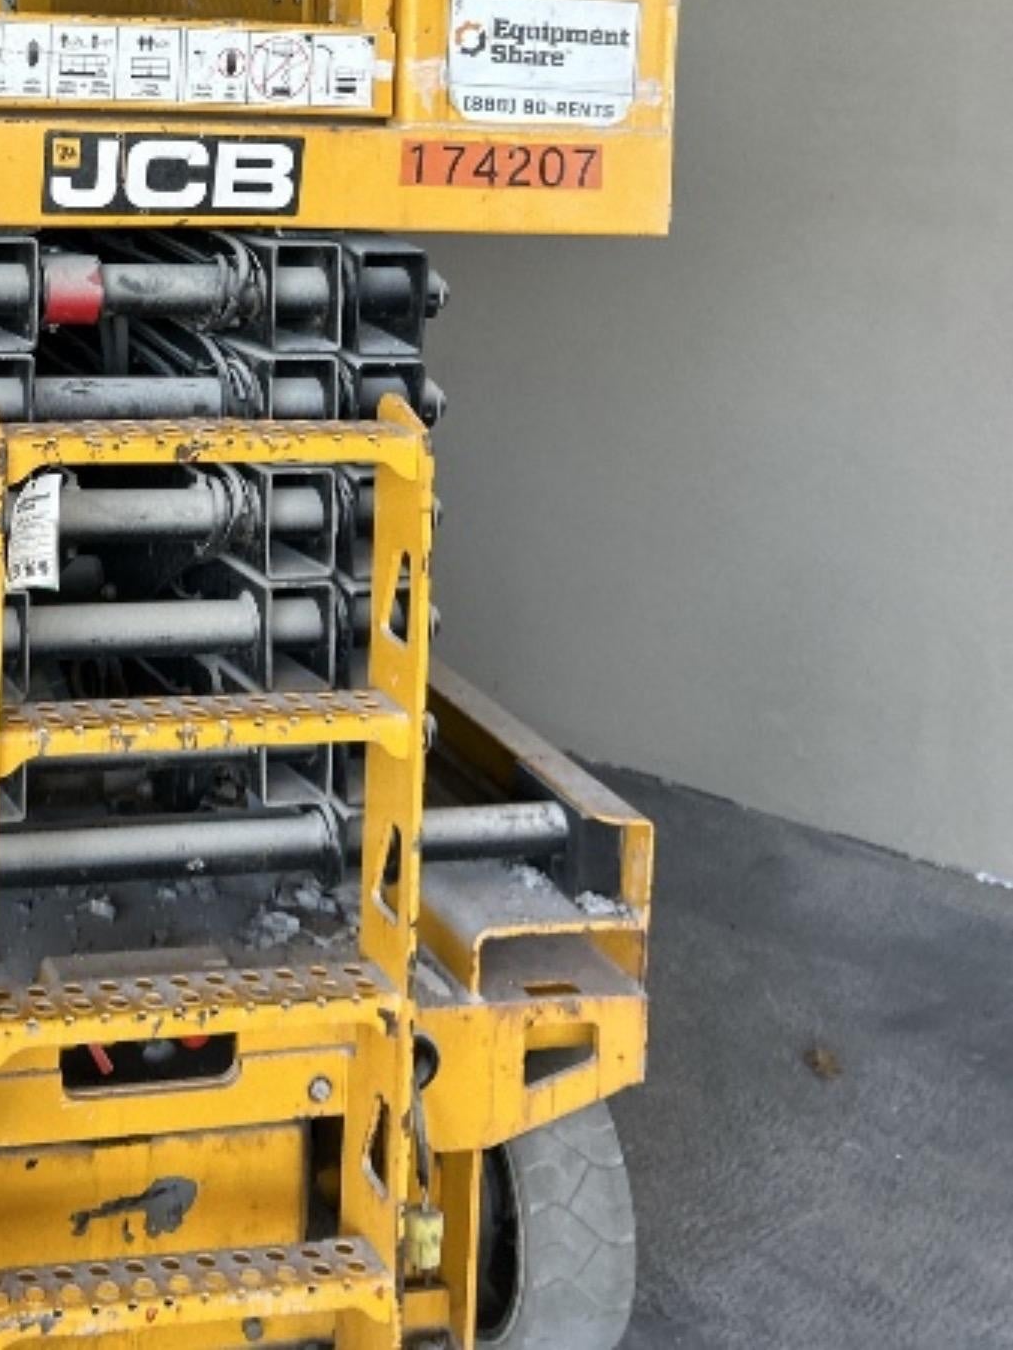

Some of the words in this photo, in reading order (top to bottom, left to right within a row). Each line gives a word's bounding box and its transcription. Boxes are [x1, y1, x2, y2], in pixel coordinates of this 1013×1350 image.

[492, 17, 630, 46] Equipment
[491, 44, 565, 67] Share
[50, 137, 295, 209] JCB
[410, 143, 597, 187] 174207
